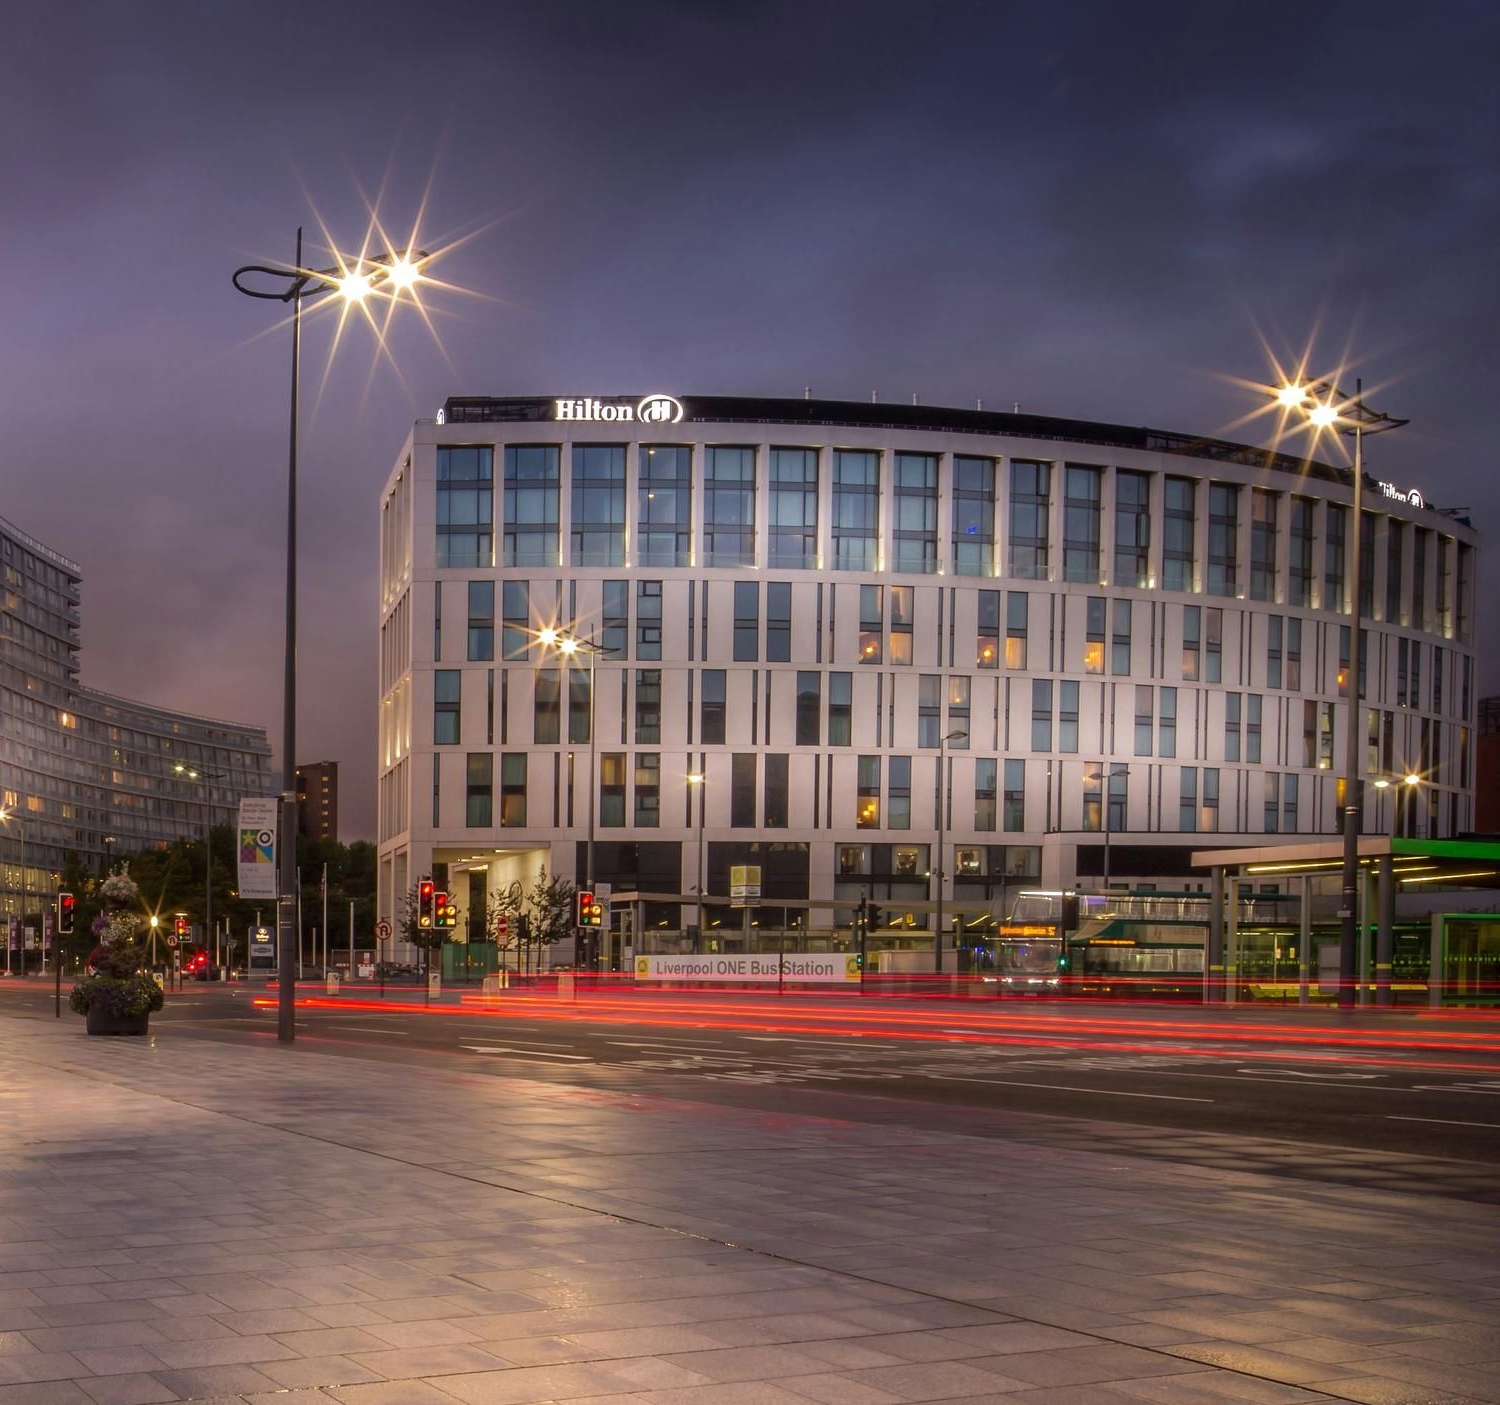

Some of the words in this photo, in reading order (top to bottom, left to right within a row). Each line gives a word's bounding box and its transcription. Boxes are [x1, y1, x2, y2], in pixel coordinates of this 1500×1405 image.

[555, 398, 634, 421] Hilton
[656, 960, 713, 978] Liverpool
[717, 960, 748, 976] ONE
[751, 960, 778, 976] Bus
[782, 960, 834, 976] Station
